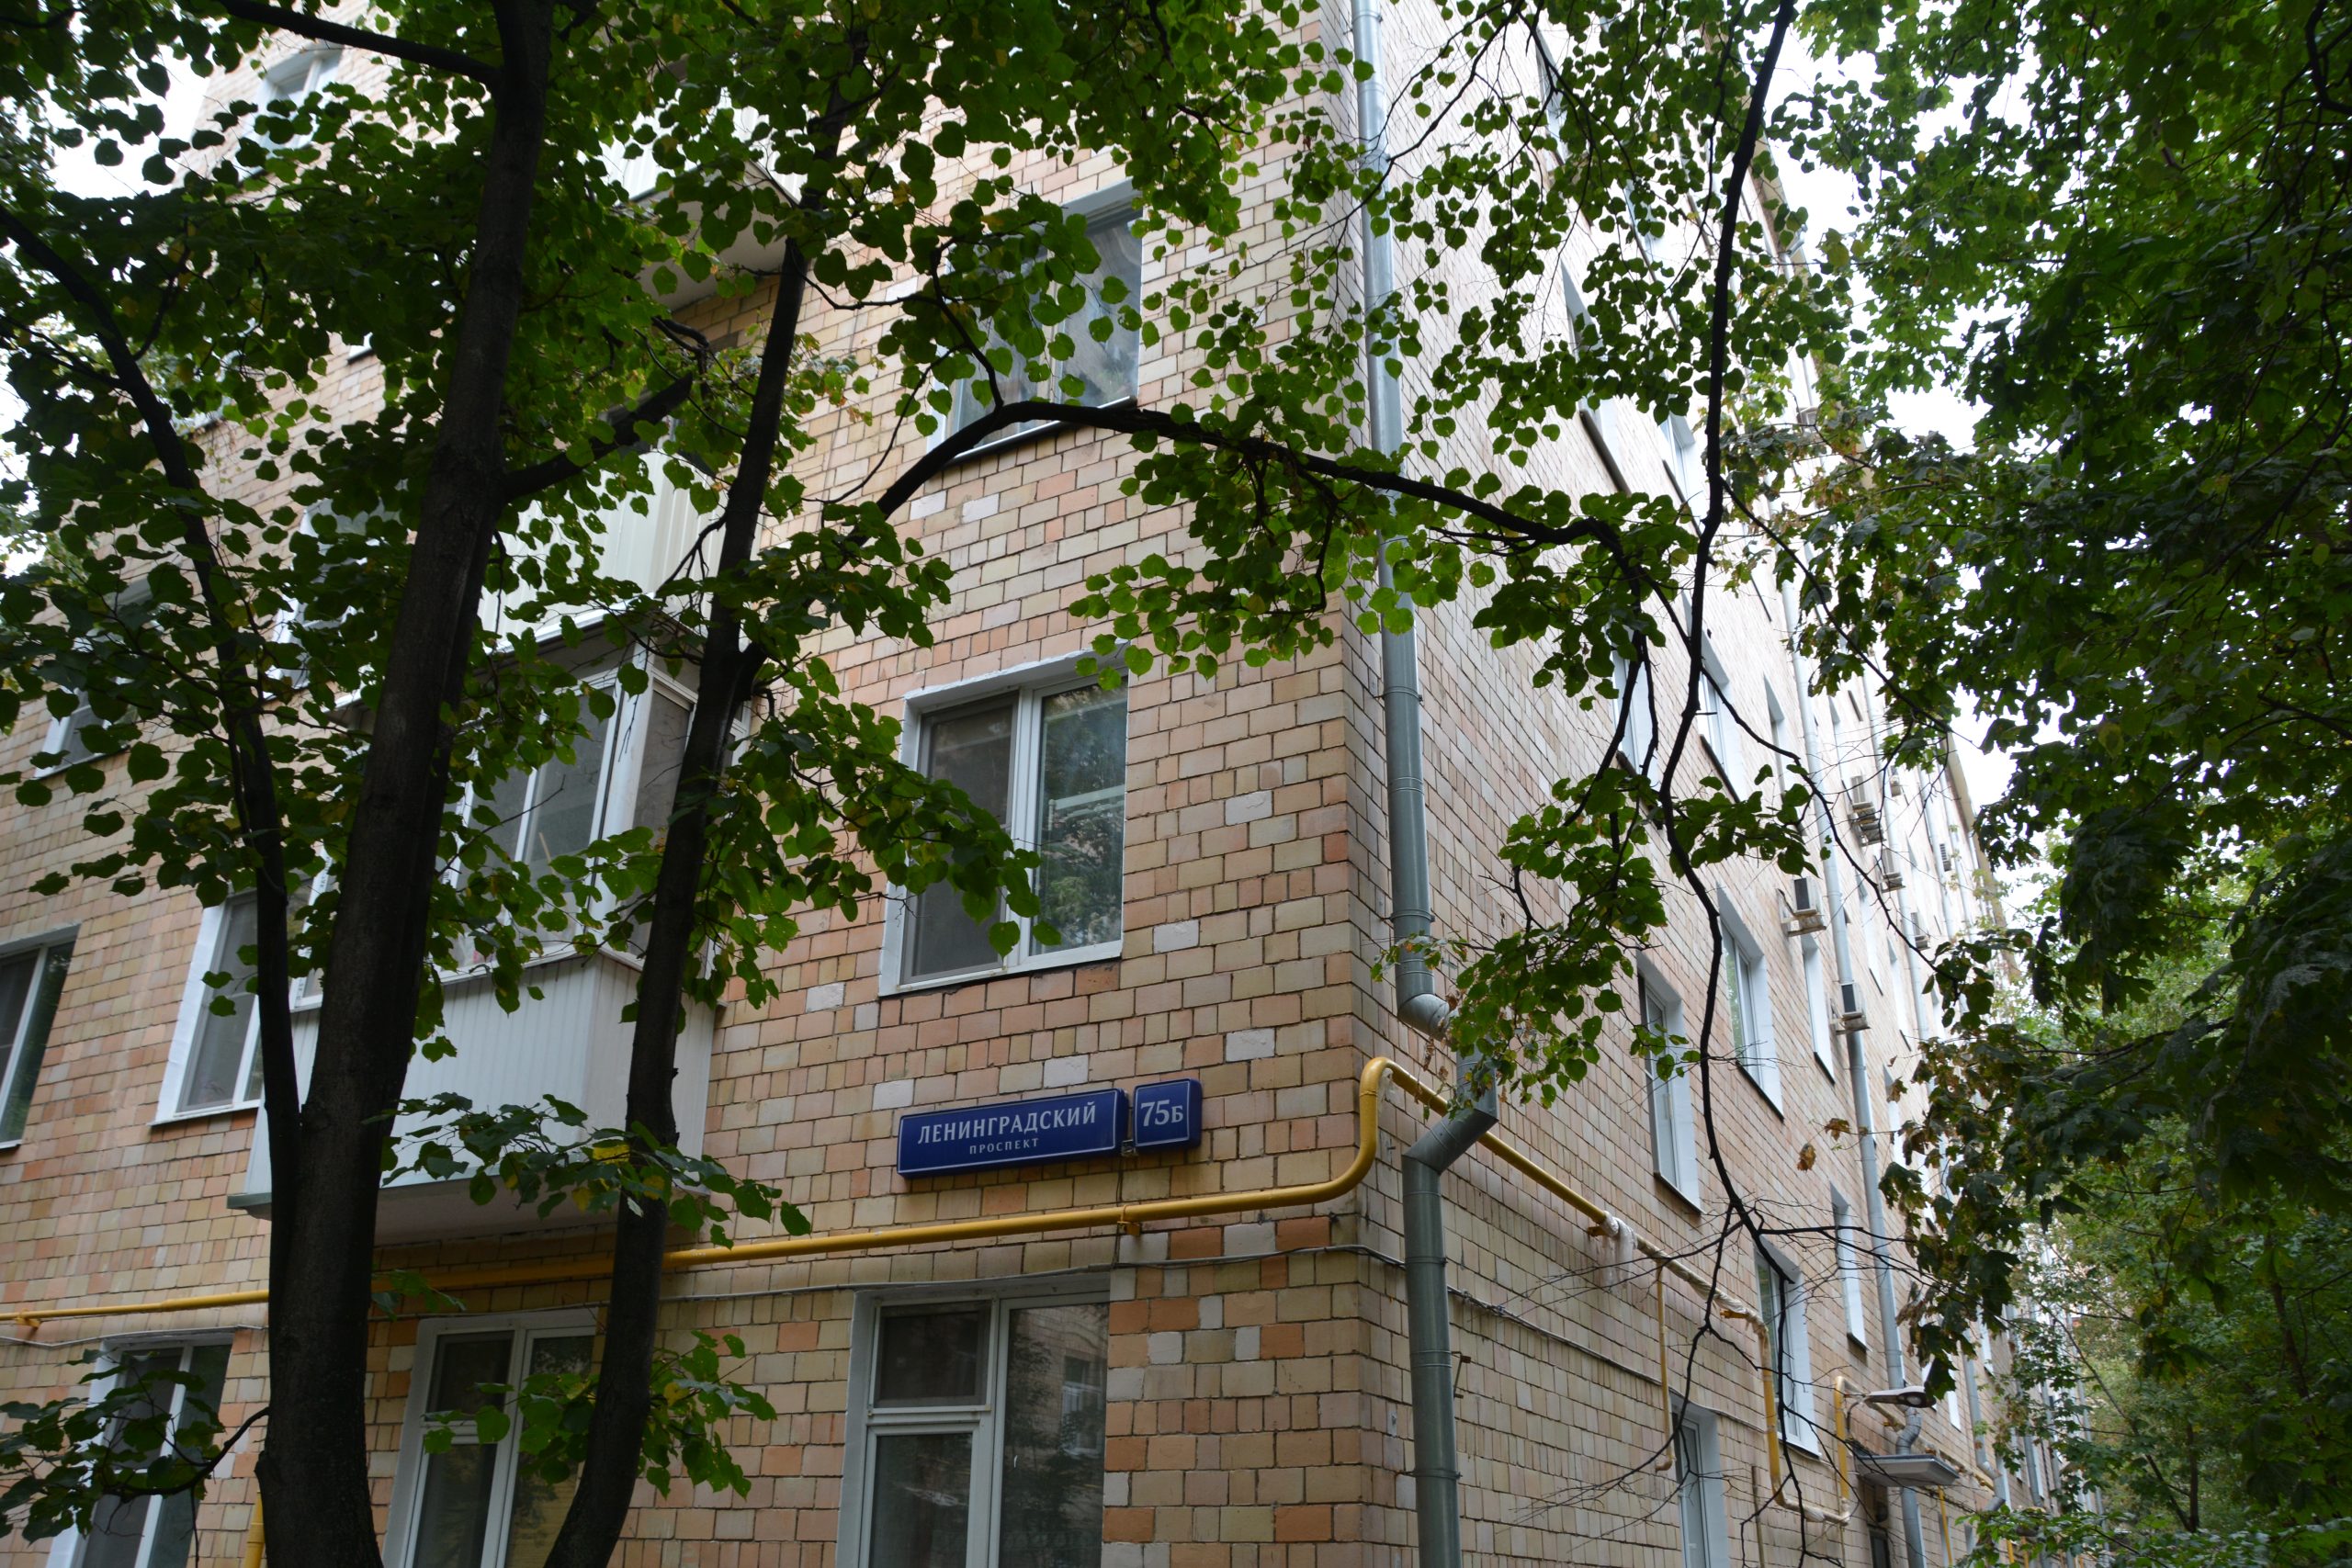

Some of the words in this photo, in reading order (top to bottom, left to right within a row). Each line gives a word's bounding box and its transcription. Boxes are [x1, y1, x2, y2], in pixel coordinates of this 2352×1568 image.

[918, 1101, 1096, 1145] ЛЕНИНГРАДСКИЙ
[1139, 1100, 1184, 1127] 75Б
[969, 1137, 1040, 1155] ПРОСПЕКТ
